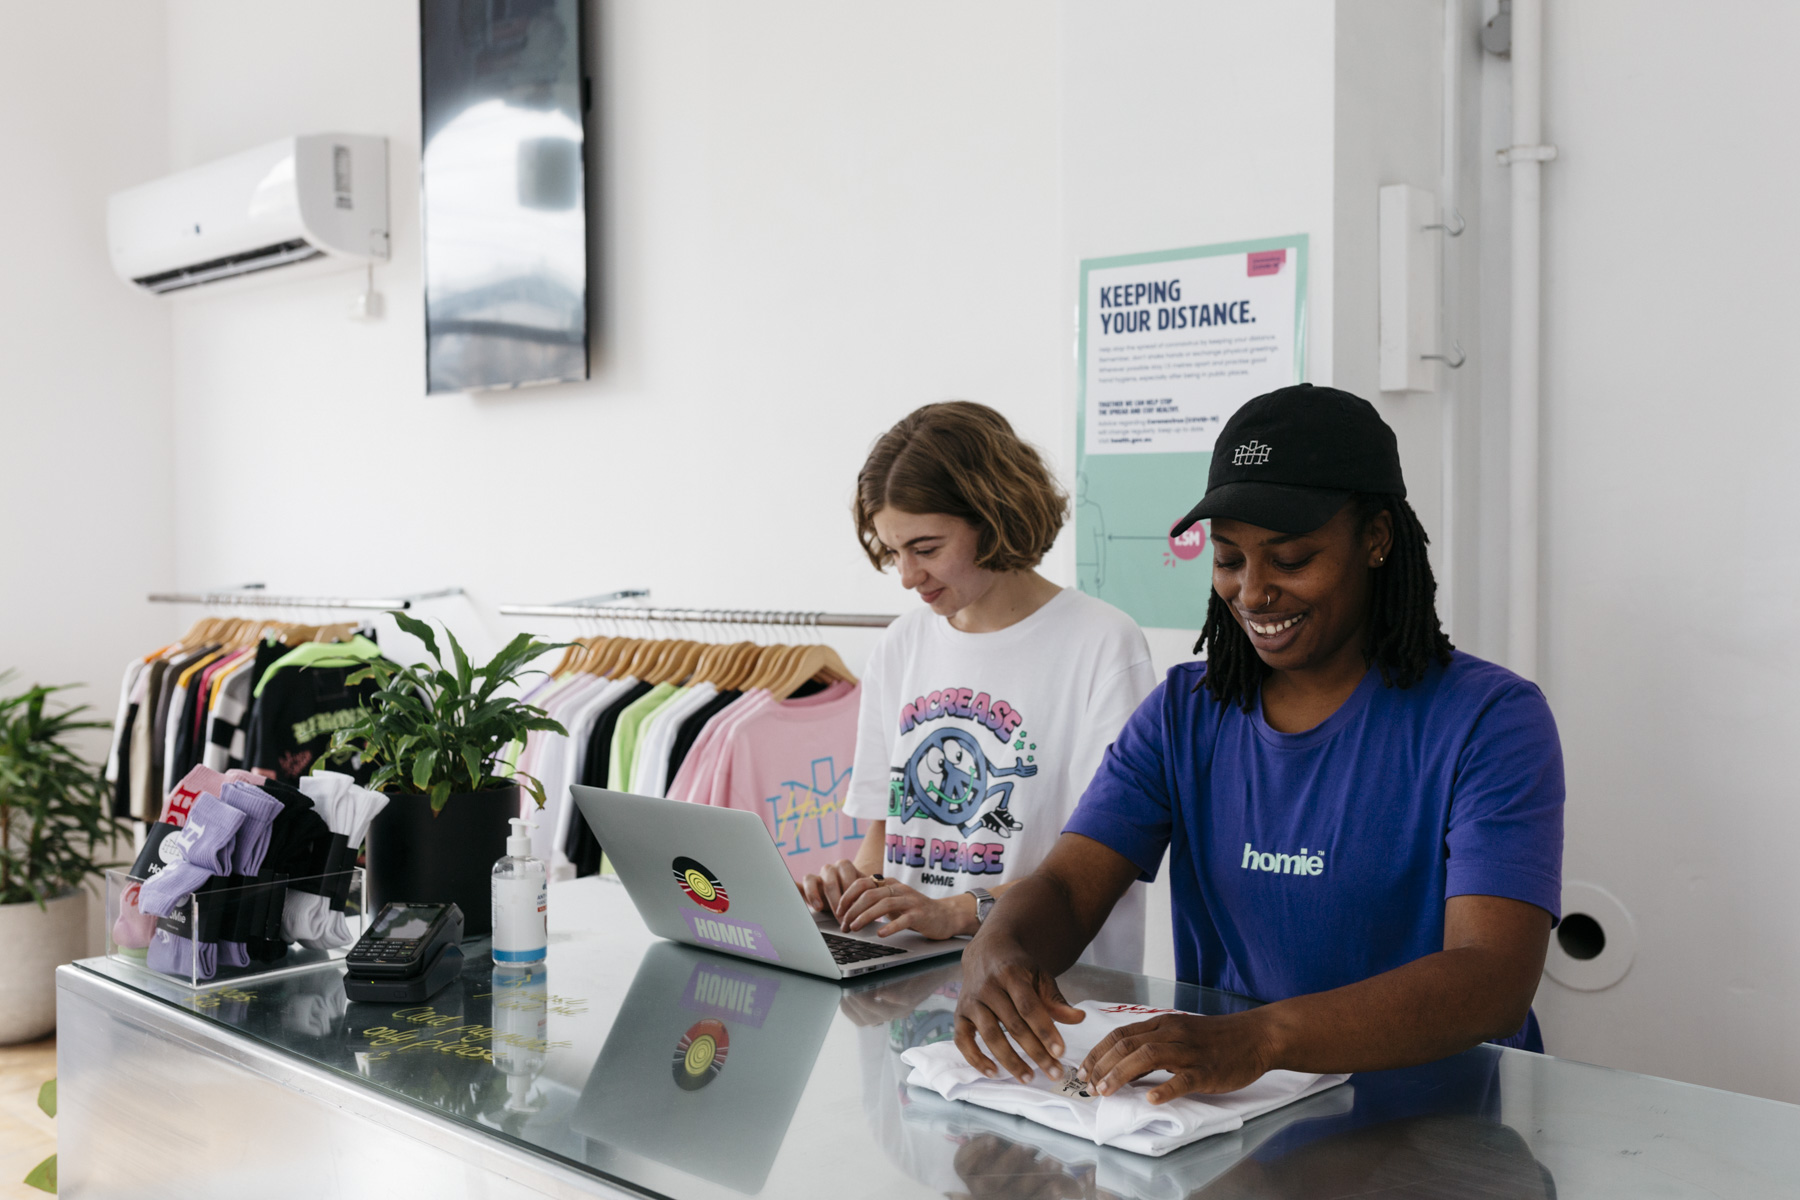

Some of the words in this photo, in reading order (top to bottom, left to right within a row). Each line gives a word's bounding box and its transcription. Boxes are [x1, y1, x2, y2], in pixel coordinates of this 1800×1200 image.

[1100, 279, 1181, 309] KEEPING
[1100, 310, 1151, 335] YOUR
[1158, 300, 1256, 331] DISTANCE.
[899, 687, 1022, 744] INCREASE
[886, 834, 925, 868] THE
[929, 838, 1004, 875] PEACE
[1241, 843, 1324, 876] homie
[921, 873, 955, 887] HOMIE
[694, 917, 758, 950] HOMIE
[392, 1006, 464, 1027] Card
[363, 1026, 420, 1047] only
[397, 1039, 507, 1061] please
